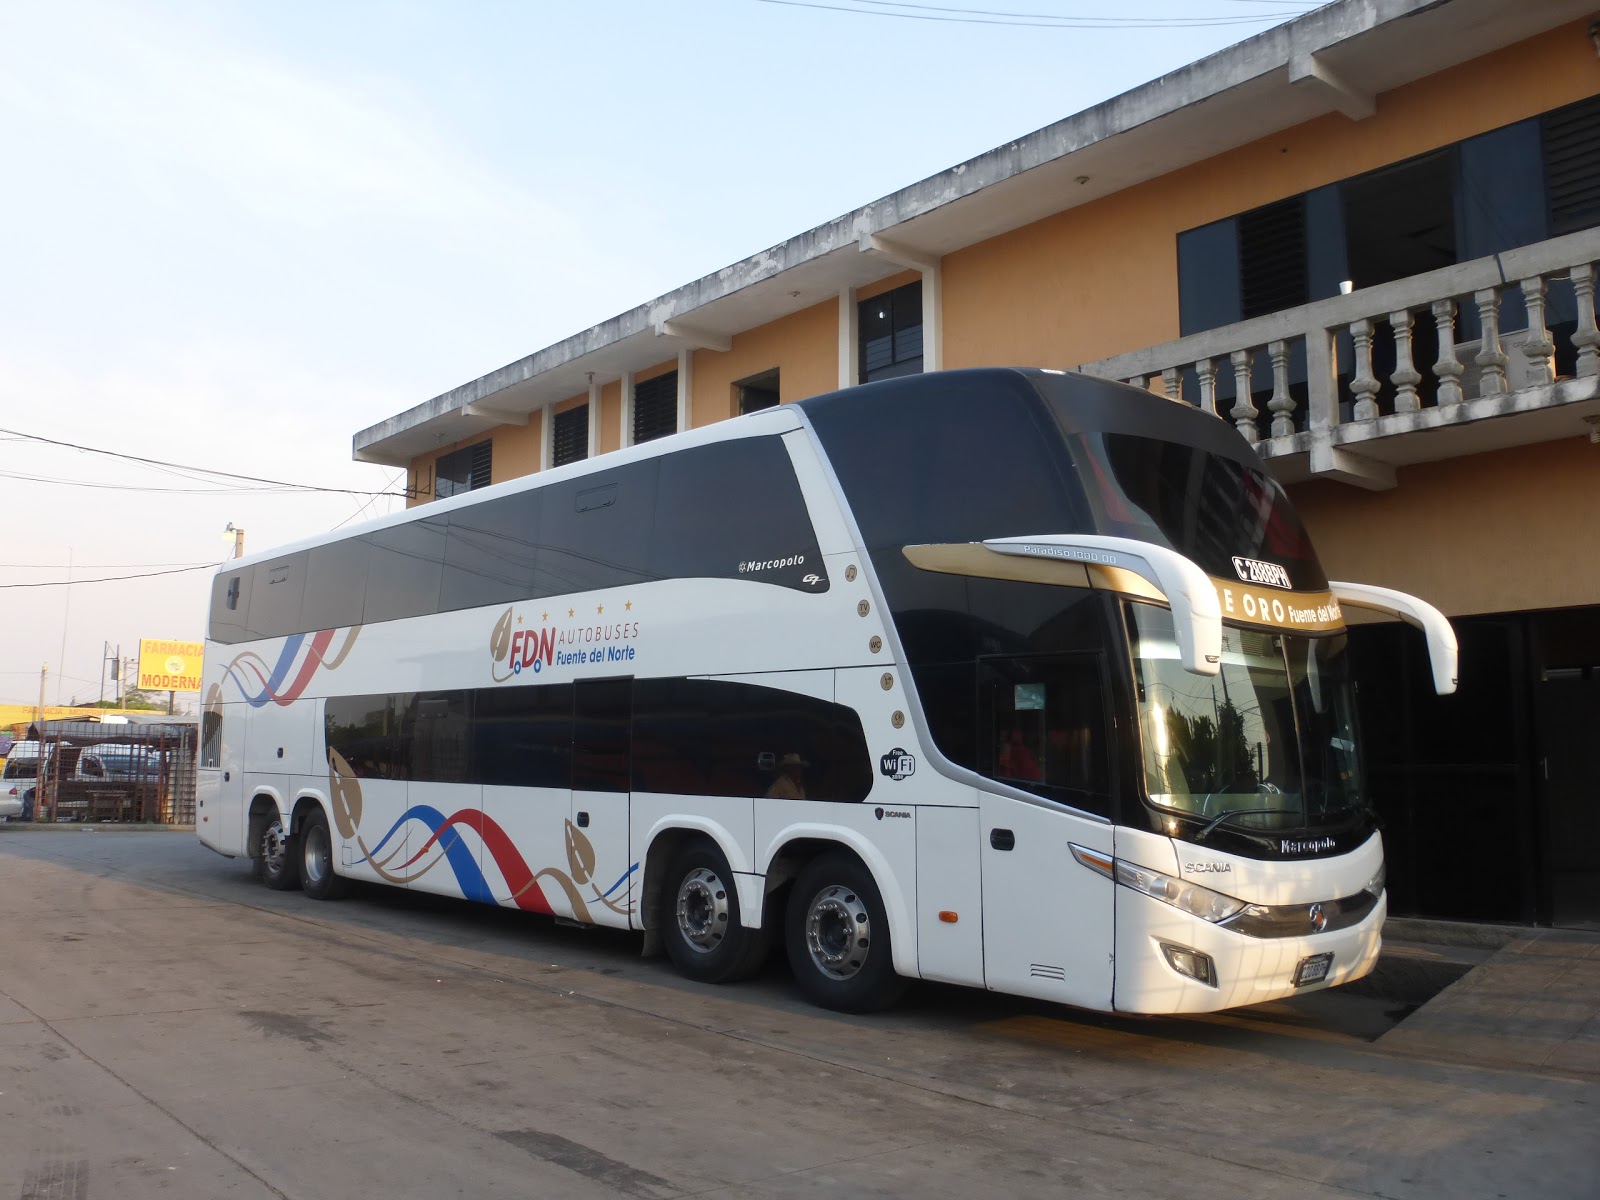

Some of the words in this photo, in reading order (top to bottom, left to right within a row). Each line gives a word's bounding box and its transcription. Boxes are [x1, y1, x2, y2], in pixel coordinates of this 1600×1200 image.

[1023, 545, 1070, 557] Paradiso
[746, 554, 805, 572] Marcopolo
[860, 603, 868, 611] TV
[1243, 594, 1284, 622] ORO
[1287, 605, 1317, 623] Fuente
[1317, 605, 1330, 622] del
[508, 626, 557, 670] FDN
[558, 622, 640, 645] AUTOBUSES
[556, 649, 587, 666] Fuente
[589, 648, 605, 663] del
[607, 645, 636, 662] Norte
[22, 706, 63, 715] FARACIA
[884, 811, 911, 819] SCANIA
[1281, 837, 1336, 853] Marcopolo
[1184, 862, 1232, 873] SCANIA
